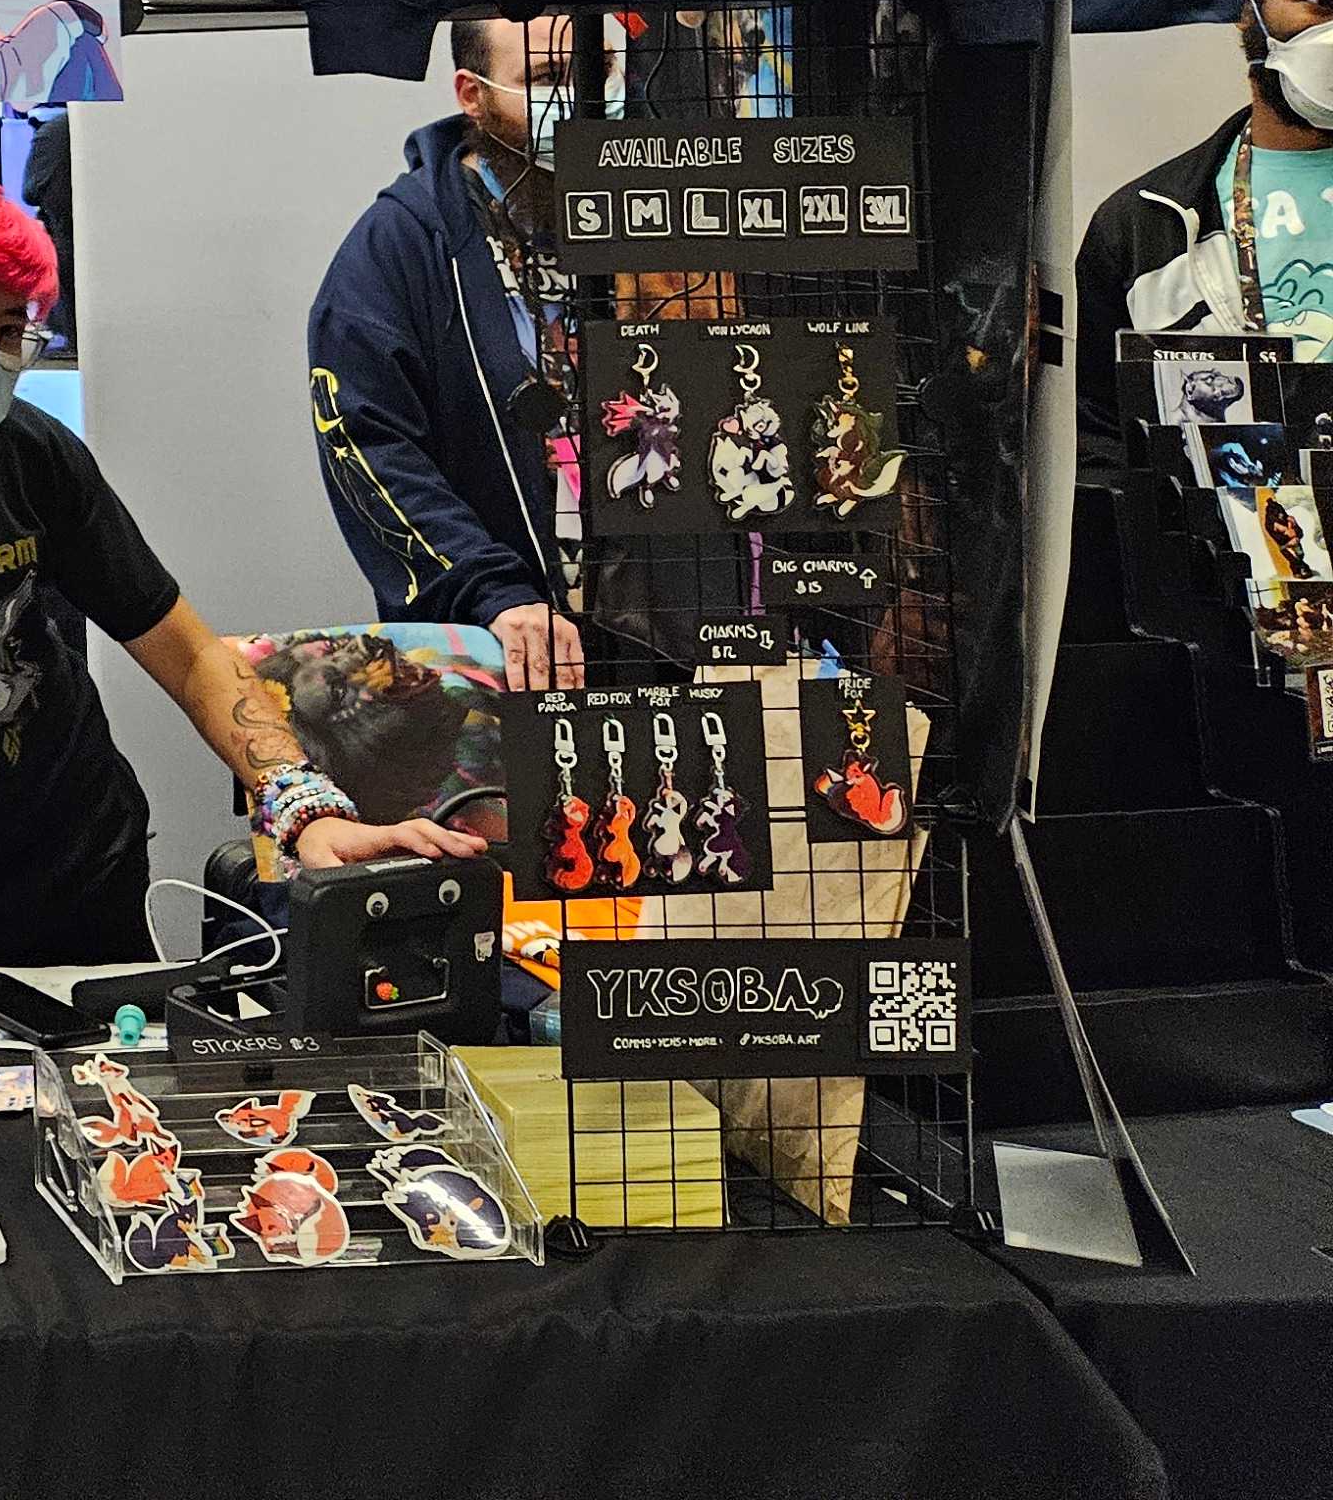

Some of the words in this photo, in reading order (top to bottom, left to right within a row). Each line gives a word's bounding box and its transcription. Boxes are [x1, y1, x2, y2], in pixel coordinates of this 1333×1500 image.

[597, 136, 742, 168] AVAILABLE
[772, 134, 856, 165] SIZES
[576, 198, 602, 233] S
[631, 196, 663, 227] M
[691, 193, 720, 229] L
[742, 197, 783, 228] XL
[802, 193, 846, 223] 2XL
[864, 194, 906, 225] 3XL
[621, 324, 660, 336] DEATH
[707, 325, 729, 336] VON
[730, 323, 771, 336] LYCAON
[808, 321, 841, 333] WOLF
[844, 320, 870, 333] LINK
[772, 560, 798, 574] BIG
[802, 560, 858, 575] CHARMS
[699, 623, 758, 642] CHARMS
[838, 677, 872, 690] PRIDE
[544, 692, 566, 703] RED
[637, 686, 680, 698] MARBLE
[688, 687, 724, 700] HUSKY
[843, 689, 864, 700] FOX
[586, 692, 609, 707] RED
[610, 692, 632, 706] FOX
[649, 696, 671, 708] FOX
[537, 701, 577, 714] PANDA
[586, 966, 843, 1020] YKSOBA
[192, 1036, 283, 1055] STICKERS
[289, 1036, 321, 1052] $3
